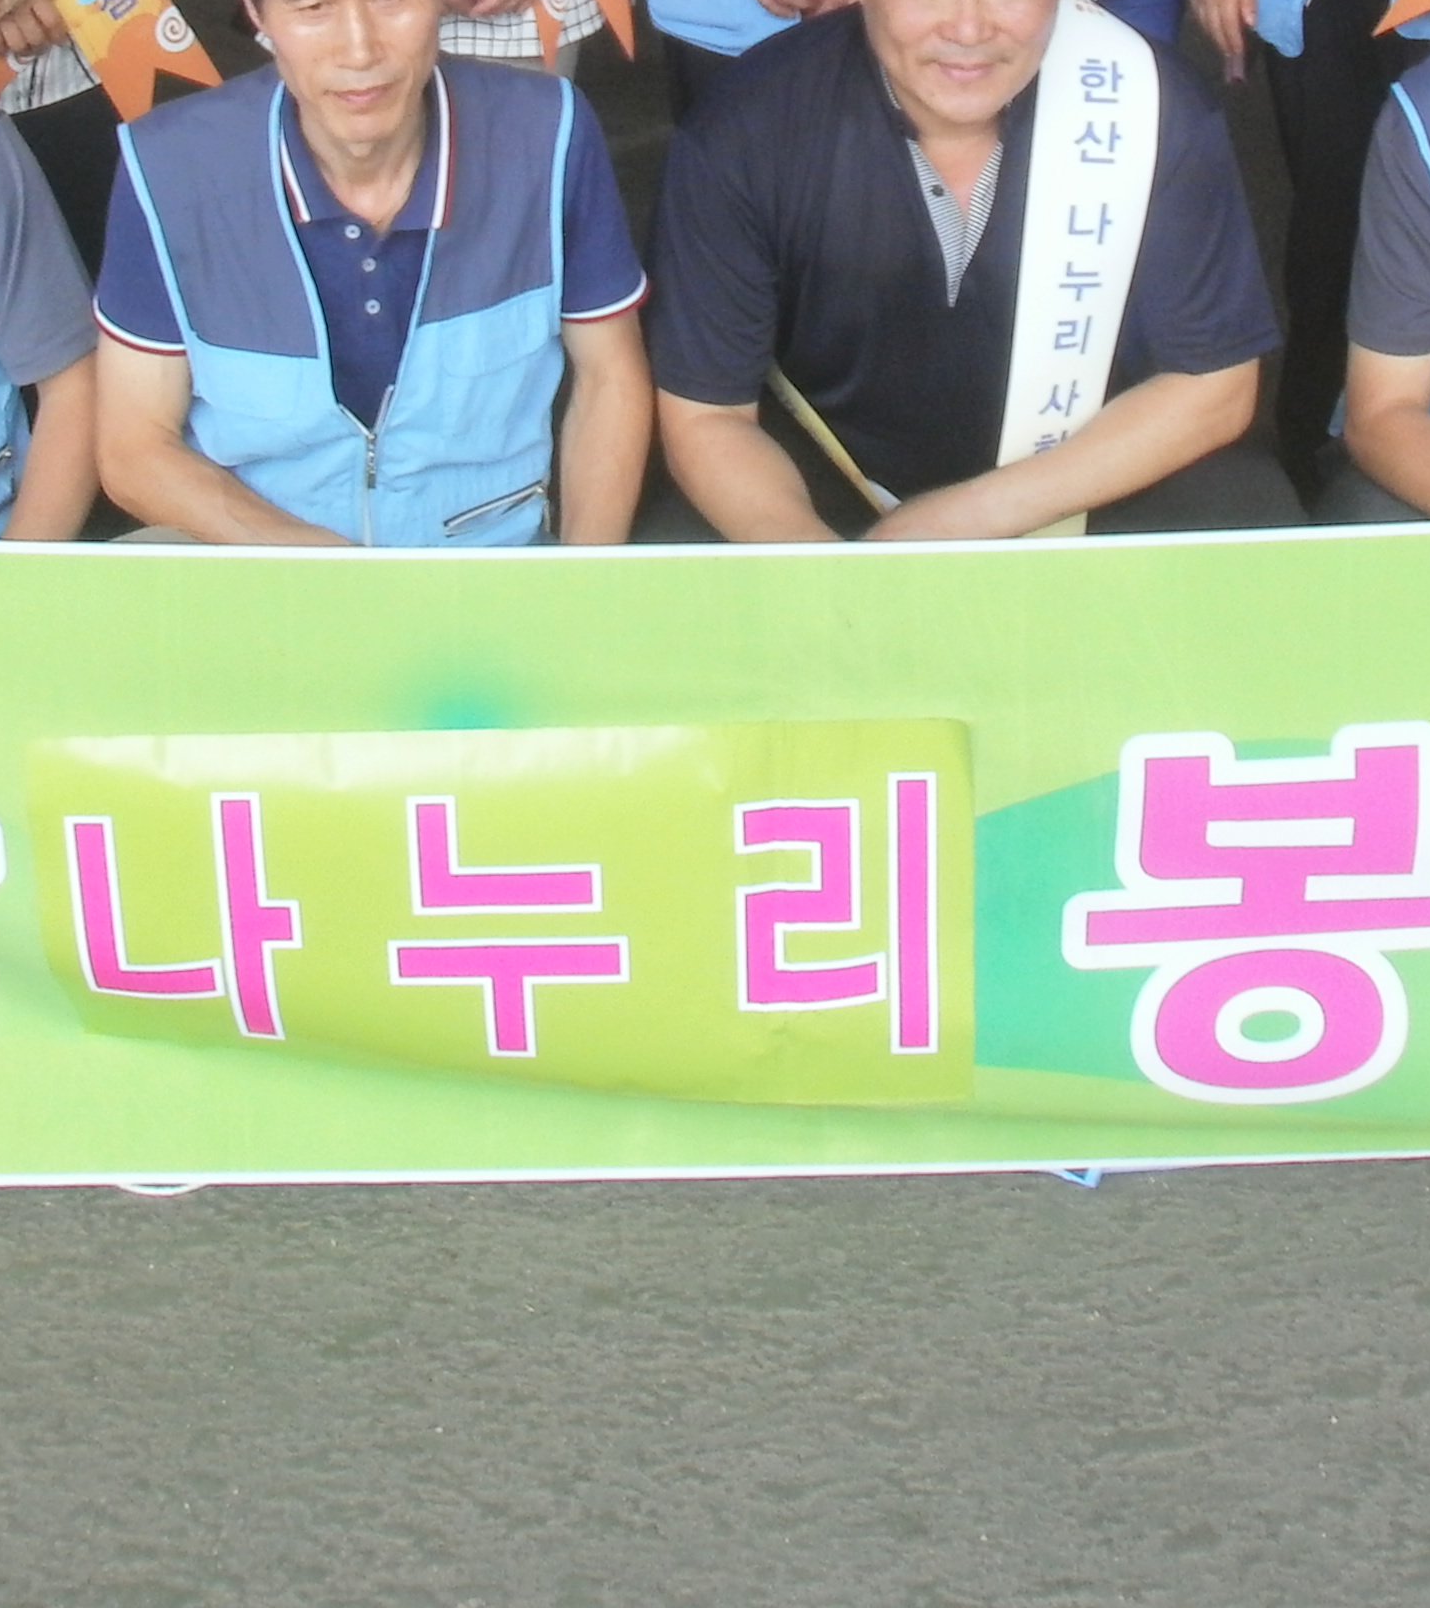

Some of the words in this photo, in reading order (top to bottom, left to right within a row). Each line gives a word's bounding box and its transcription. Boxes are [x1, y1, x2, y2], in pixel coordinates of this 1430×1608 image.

[1074, 57, 1125, 166] 한산
[1052, 200, 1114, 356] 나누리
[69, 767, 940, 1060] 나누리
